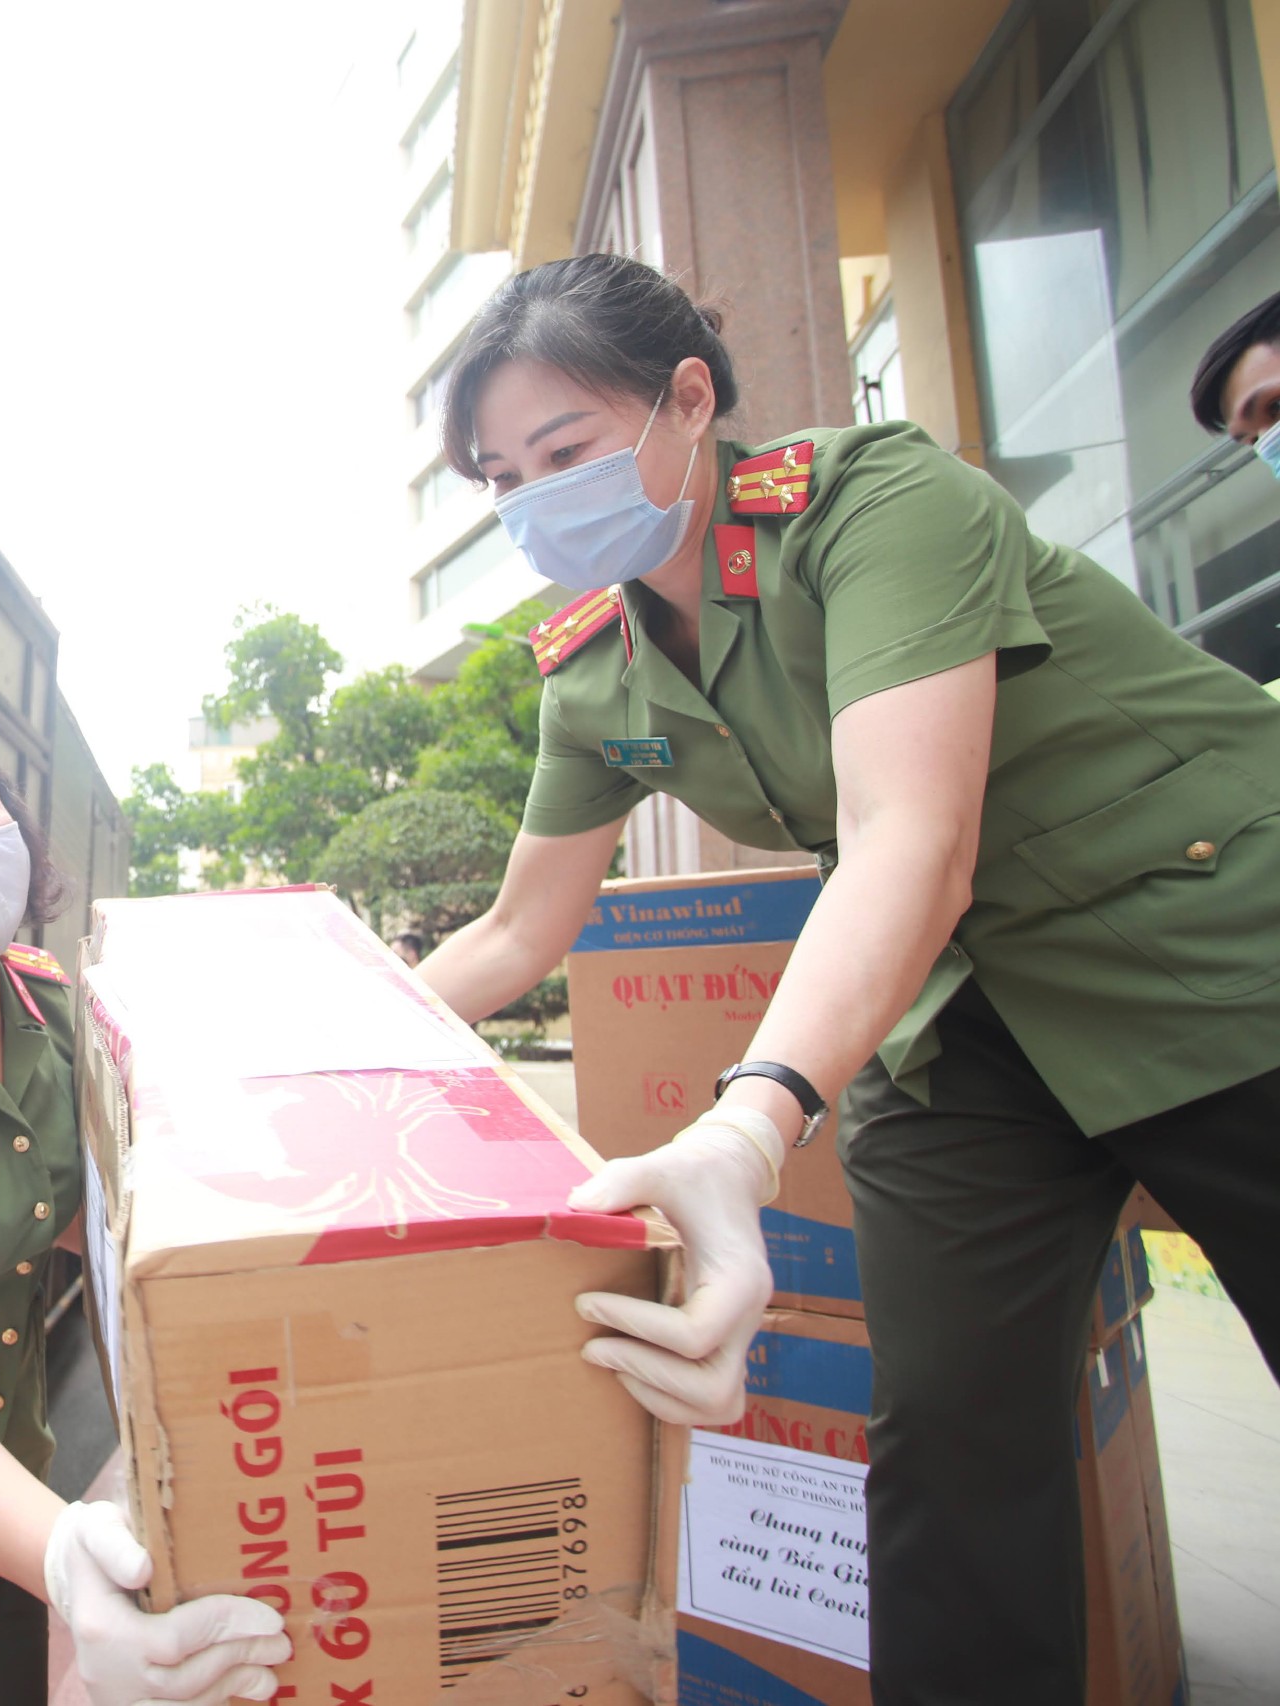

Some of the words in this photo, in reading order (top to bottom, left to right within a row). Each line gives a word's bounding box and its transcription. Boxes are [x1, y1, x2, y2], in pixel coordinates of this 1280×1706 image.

[609, 895, 743, 923] Vinawind
[612, 973, 694, 1011] QUẠT
[221, 1366, 285, 1478] GÓI
[710, 1455, 731, 1469] HỘI
[734, 1461, 759, 1475] PHỤ
[783, 1470, 817, 1486] CÔNG
[822, 1479, 838, 1491] AN
[728, 1474, 749, 1487] HỘI
[752, 1480, 778, 1494] PHỤ
[304, 1448, 368, 1553] TÚI
[750, 1508, 822, 1543] Chung
[831, 1531, 868, 1556] tay
[720, 1535, 769, 1562] cùng
[778, 1547, 825, 1574] Bắc
[721, 1565, 761, 1592] đẩy
[770, 1576, 801, 1600] lùi
[311, 1571, 371, 1661] 60
